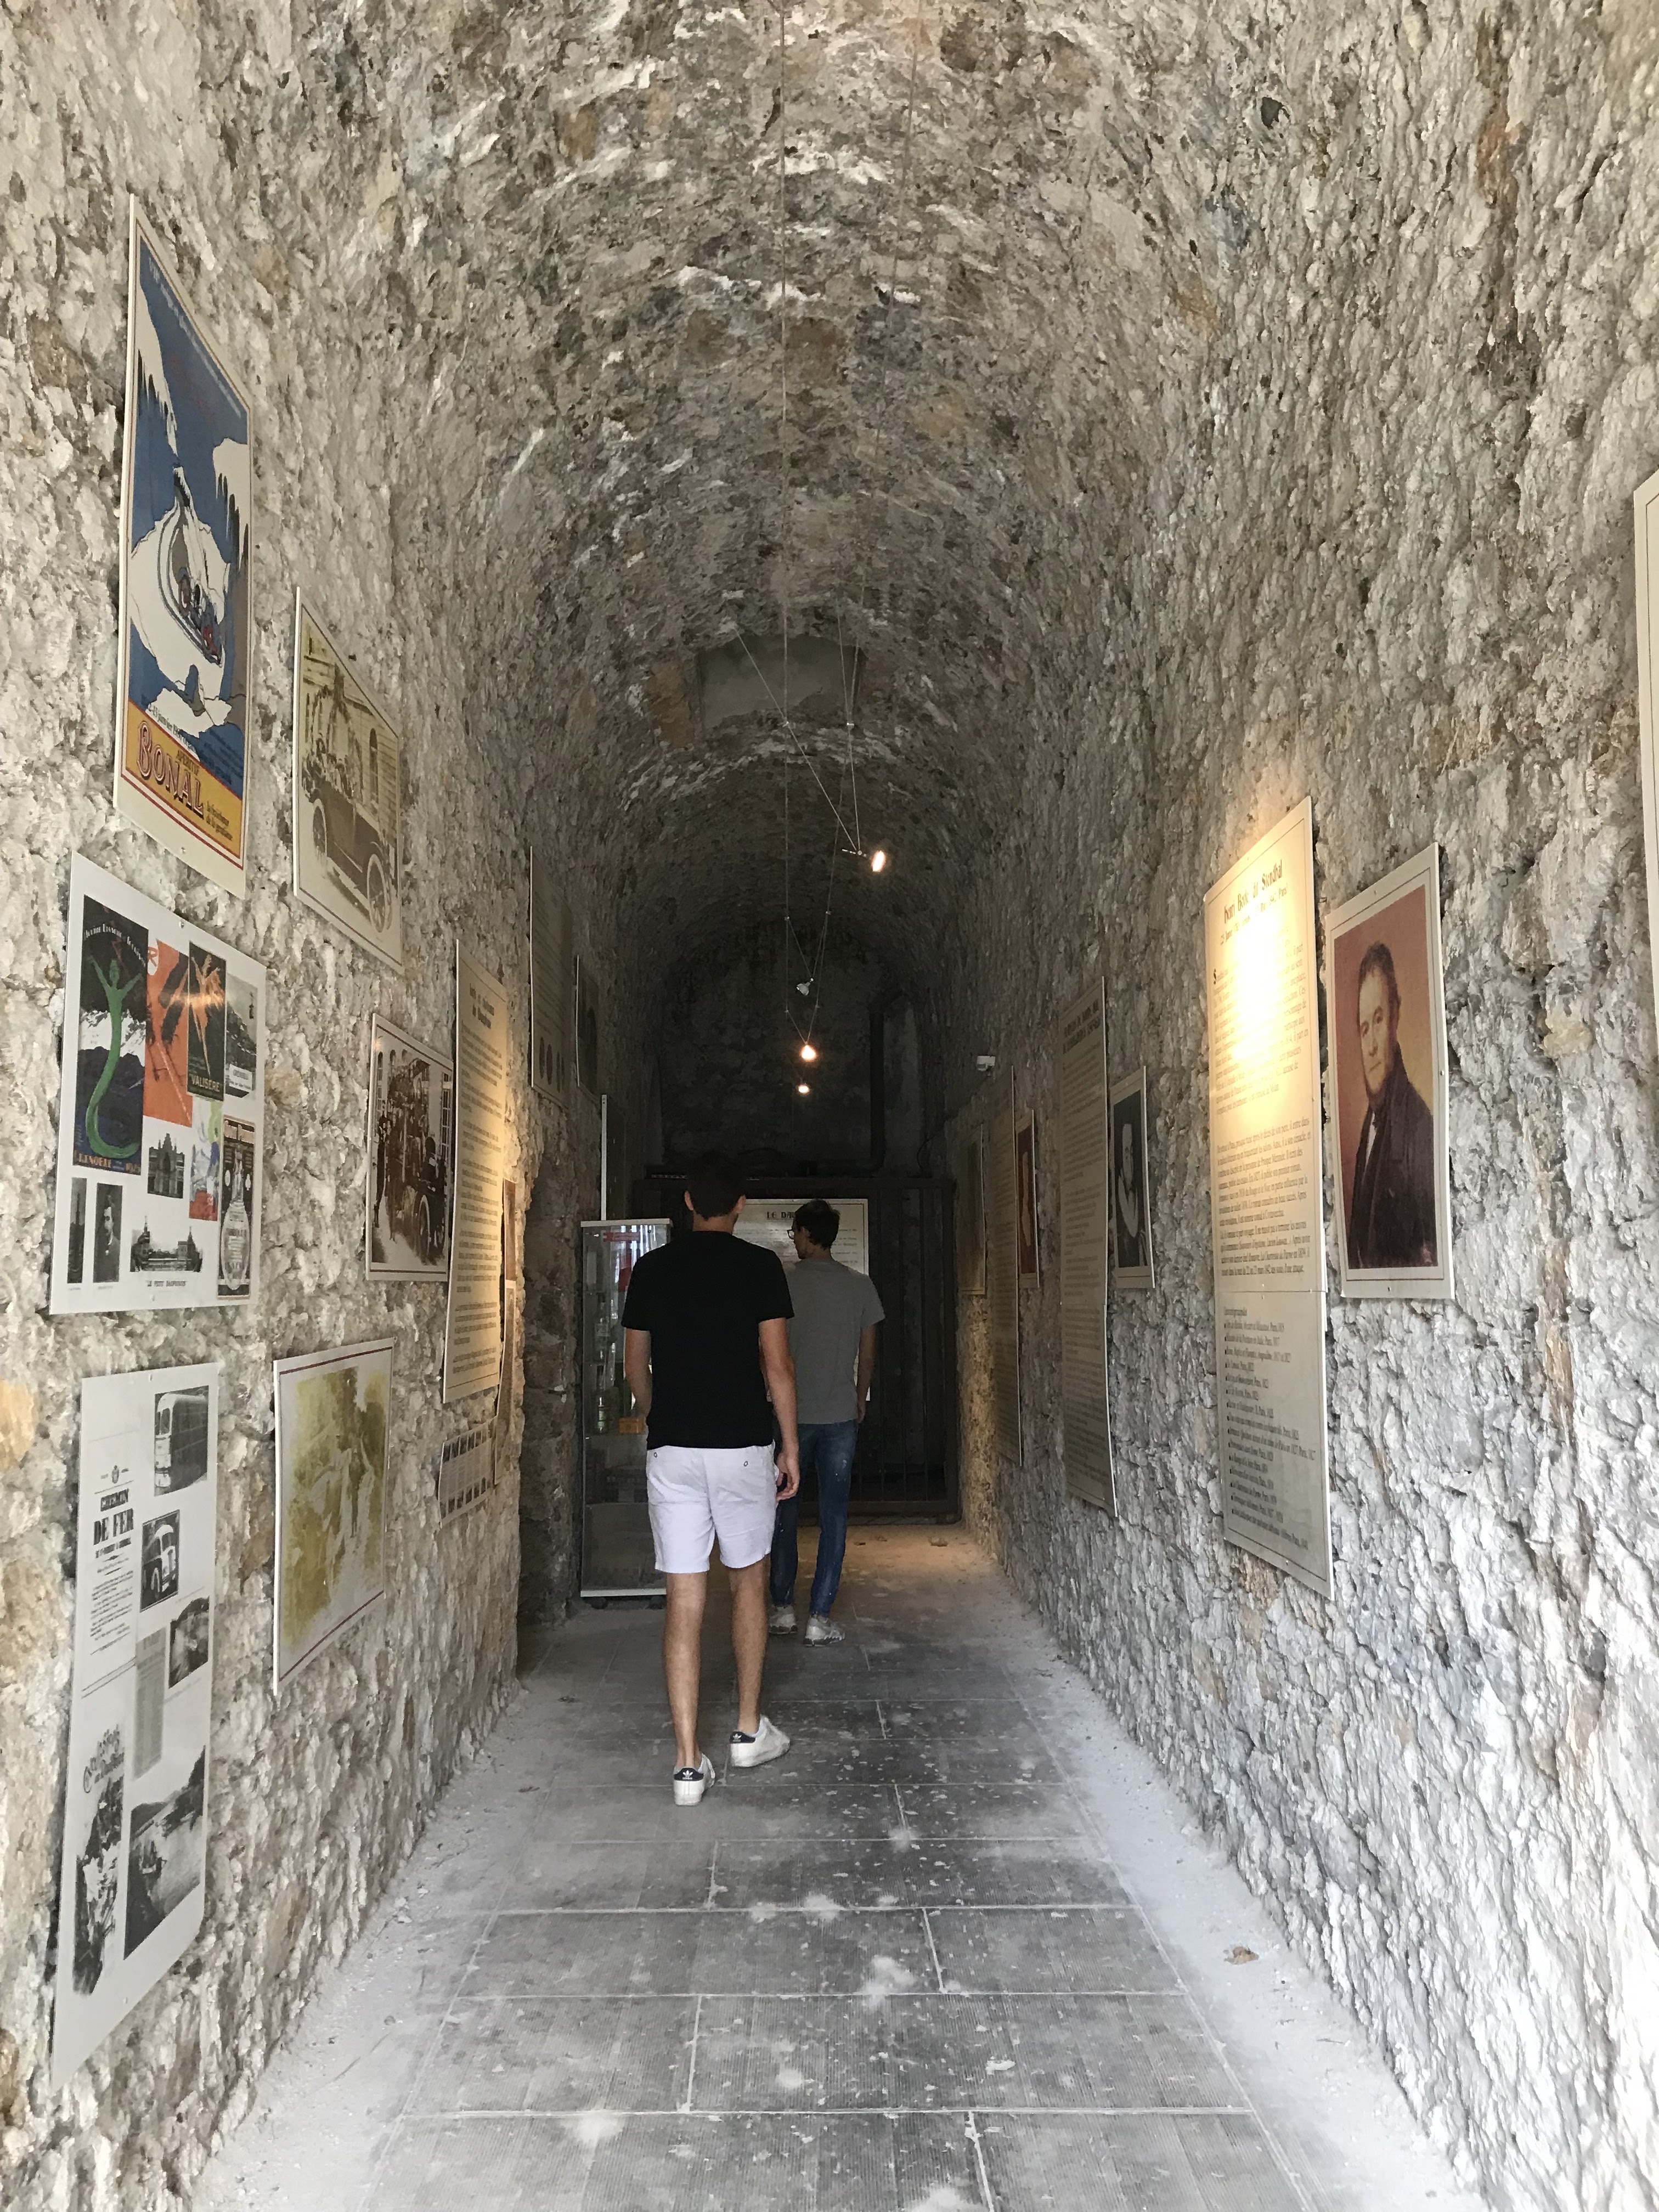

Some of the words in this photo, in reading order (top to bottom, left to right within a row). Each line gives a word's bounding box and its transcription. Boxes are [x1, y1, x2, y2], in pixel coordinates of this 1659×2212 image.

[137, 720, 204, 820] BONAL
[1262, 859, 1283, 890] Stendhal
[93, 1516, 109, 1546] DE
[113, 1508, 134, 1537] FER
